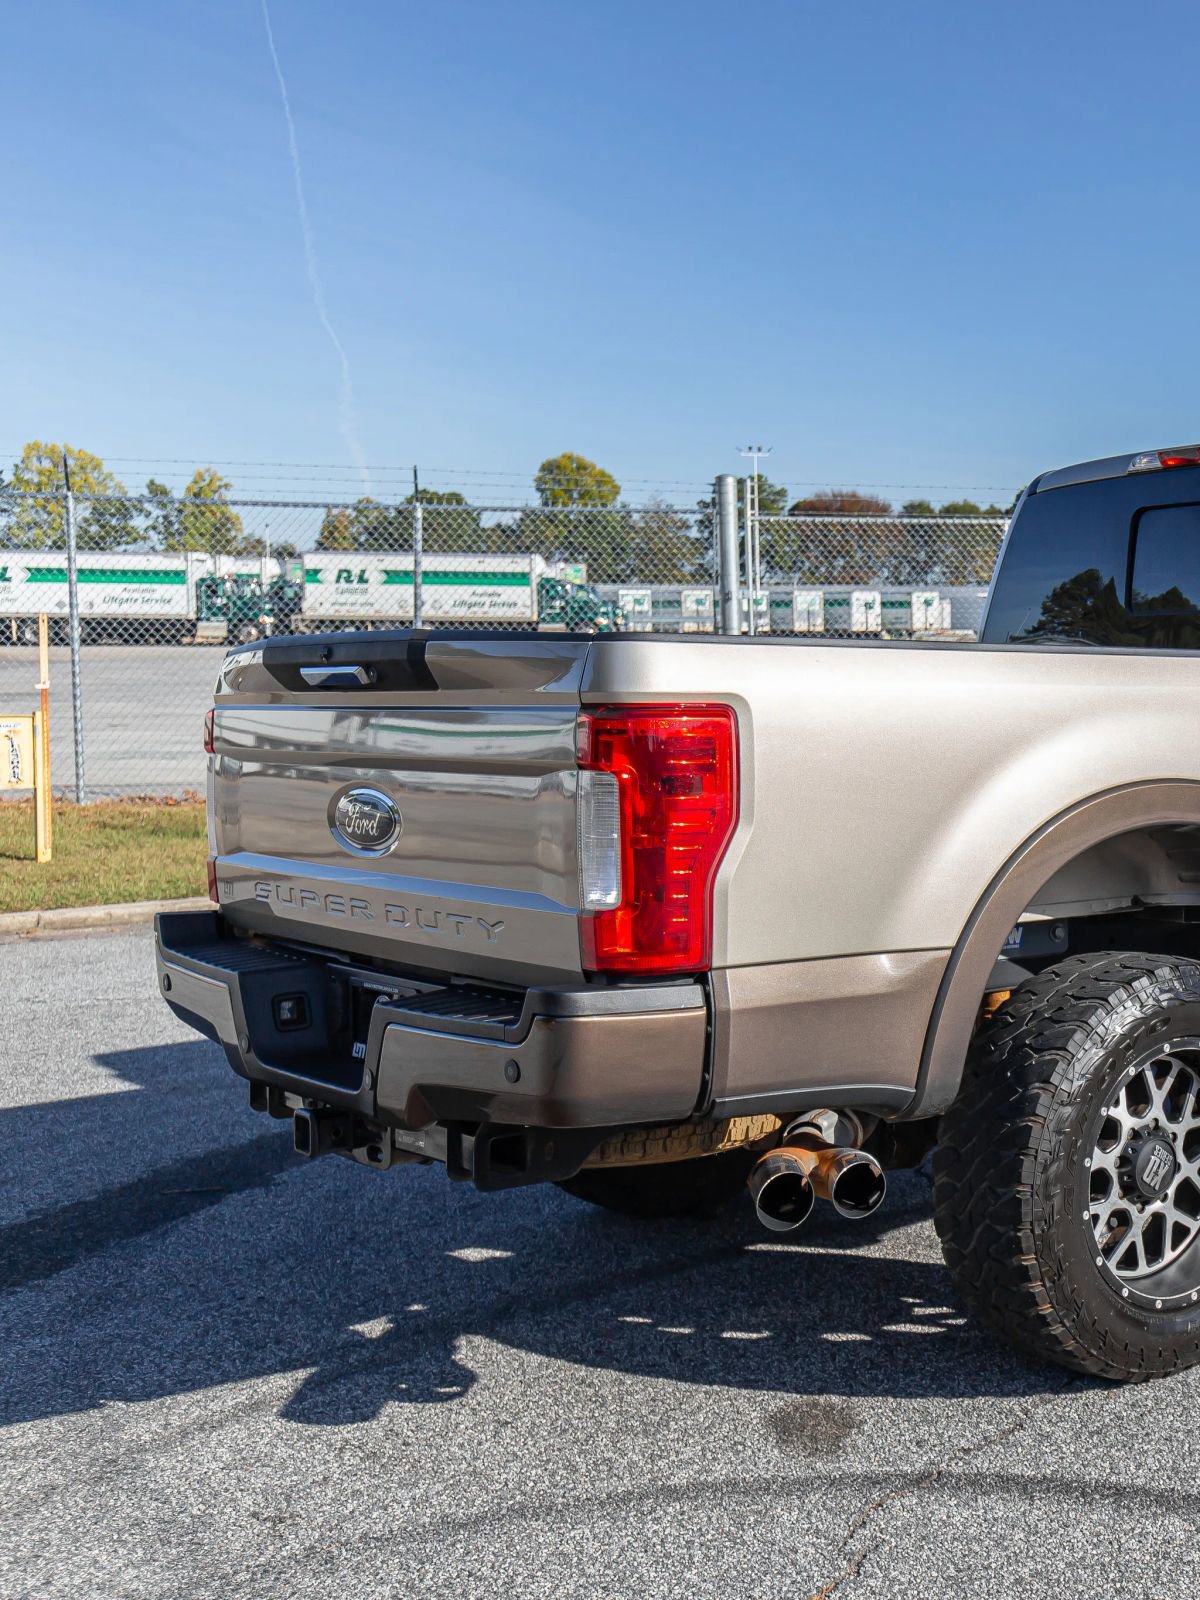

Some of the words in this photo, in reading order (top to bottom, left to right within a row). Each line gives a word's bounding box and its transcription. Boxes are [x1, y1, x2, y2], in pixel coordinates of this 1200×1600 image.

[346, 802, 380, 836] Ford
[254, 881, 375, 920] SUPER
[385, 903, 505, 944] DUTY
